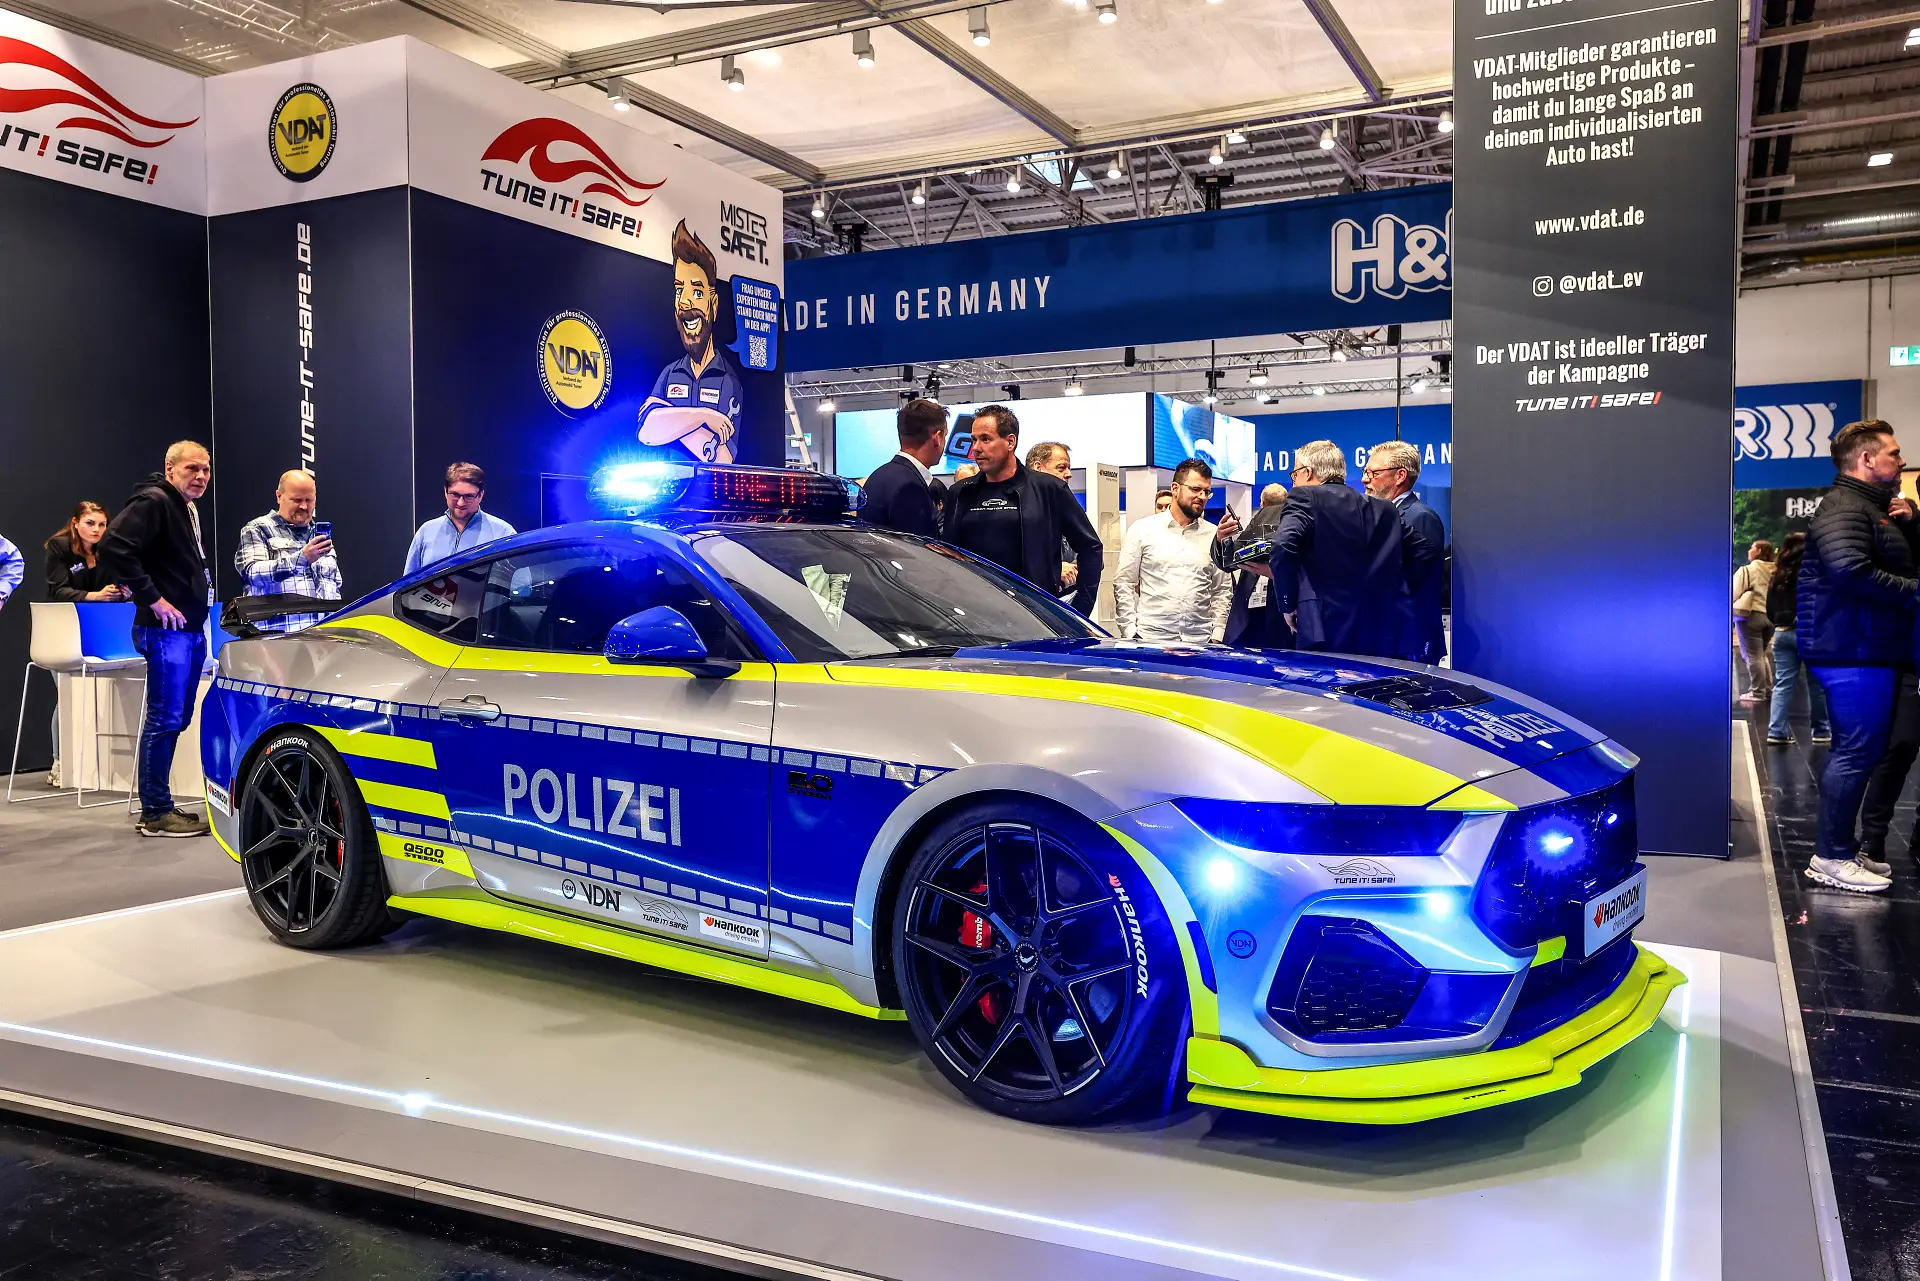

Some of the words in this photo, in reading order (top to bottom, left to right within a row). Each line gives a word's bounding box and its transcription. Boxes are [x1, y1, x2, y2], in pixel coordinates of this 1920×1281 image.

[1473, 44, 1606, 78] VDAT-Mitglieder
[1610, 26, 1717, 61] garantieren
[284, 84, 326, 101] professionelles
[1492, 69, 1596, 100] hochwertige
[1600, 56, 1681, 85] Produkte
[1492, 101, 1540, 124] damit
[1543, 98, 1565, 119] du
[1569, 93, 1616, 114] lange
[1620, 82, 1667, 109] Spaß
[1671, 82, 1694, 101] an
[277, 114, 327, 145] VDAT
[325, 98, 337, 141] Automobil
[1484, 126, 1544, 150] deinem
[1548, 105, 1702, 142] individualisierten
[0, 124, 50, 157] IT!
[319, 143, 335, 168] Tuning
[1545, 145, 1586, 167] Auto
[1590, 136, 1635, 161] hast!
[549, 192, 579, 218] IT!
[720, 200, 768, 239] MISTER
[1535, 205, 1645, 235] www.vdat.de
[1331, 210, 1452, 303] H&
[741, 283, 754, 295] FRAG
[754, 286, 772, 299] UNSERE
[1559, 270, 1644, 294] @vdat_ev
[736, 293, 758, 308] EXPERTEN
[759, 299, 769, 310] HIER
[769, 302, 777, 311] AM
[736, 305, 752, 317] STAND
[753, 309, 765, 320] ODER
[847, 293, 876, 326] IN
[895, 275, 1051, 321] GERMANY
[555, 309, 601, 336] professionelles
[744, 319, 751, 329] IN
[751, 320, 760, 331] DER
[760, 322, 771, 333] APP!
[547, 342, 601, 379] VDAT
[599, 337, 611, 386] Automobil
[1476, 345, 1504, 365] Der
[1508, 340, 1551, 363] VDAT
[1554, 339, 1576, 360] ist
[1580, 335, 1646, 358] ideeller
[1649, 332, 1708, 353] Träger
[1527, 365, 1556, 386] der
[1559, 362, 1649, 385] Kampagne
[593, 386, 609, 409] Tuning
[1570, 395, 1598, 409] IT!
[270, 736, 309, 752] Hankook
[503, 763, 682, 847] POLIZEI
[403, 842, 445, 859] Q500
[404, 851, 445, 865] STEEDA
[579, 880, 622, 913] VDAT
[1602, 882, 1642, 924] Hankook
[713, 919, 760, 937] Hankook
[725, 931, 740, 940] driving
[740, 936, 760, 944] emotion
[1113, 887, 1149, 999] Hankook
